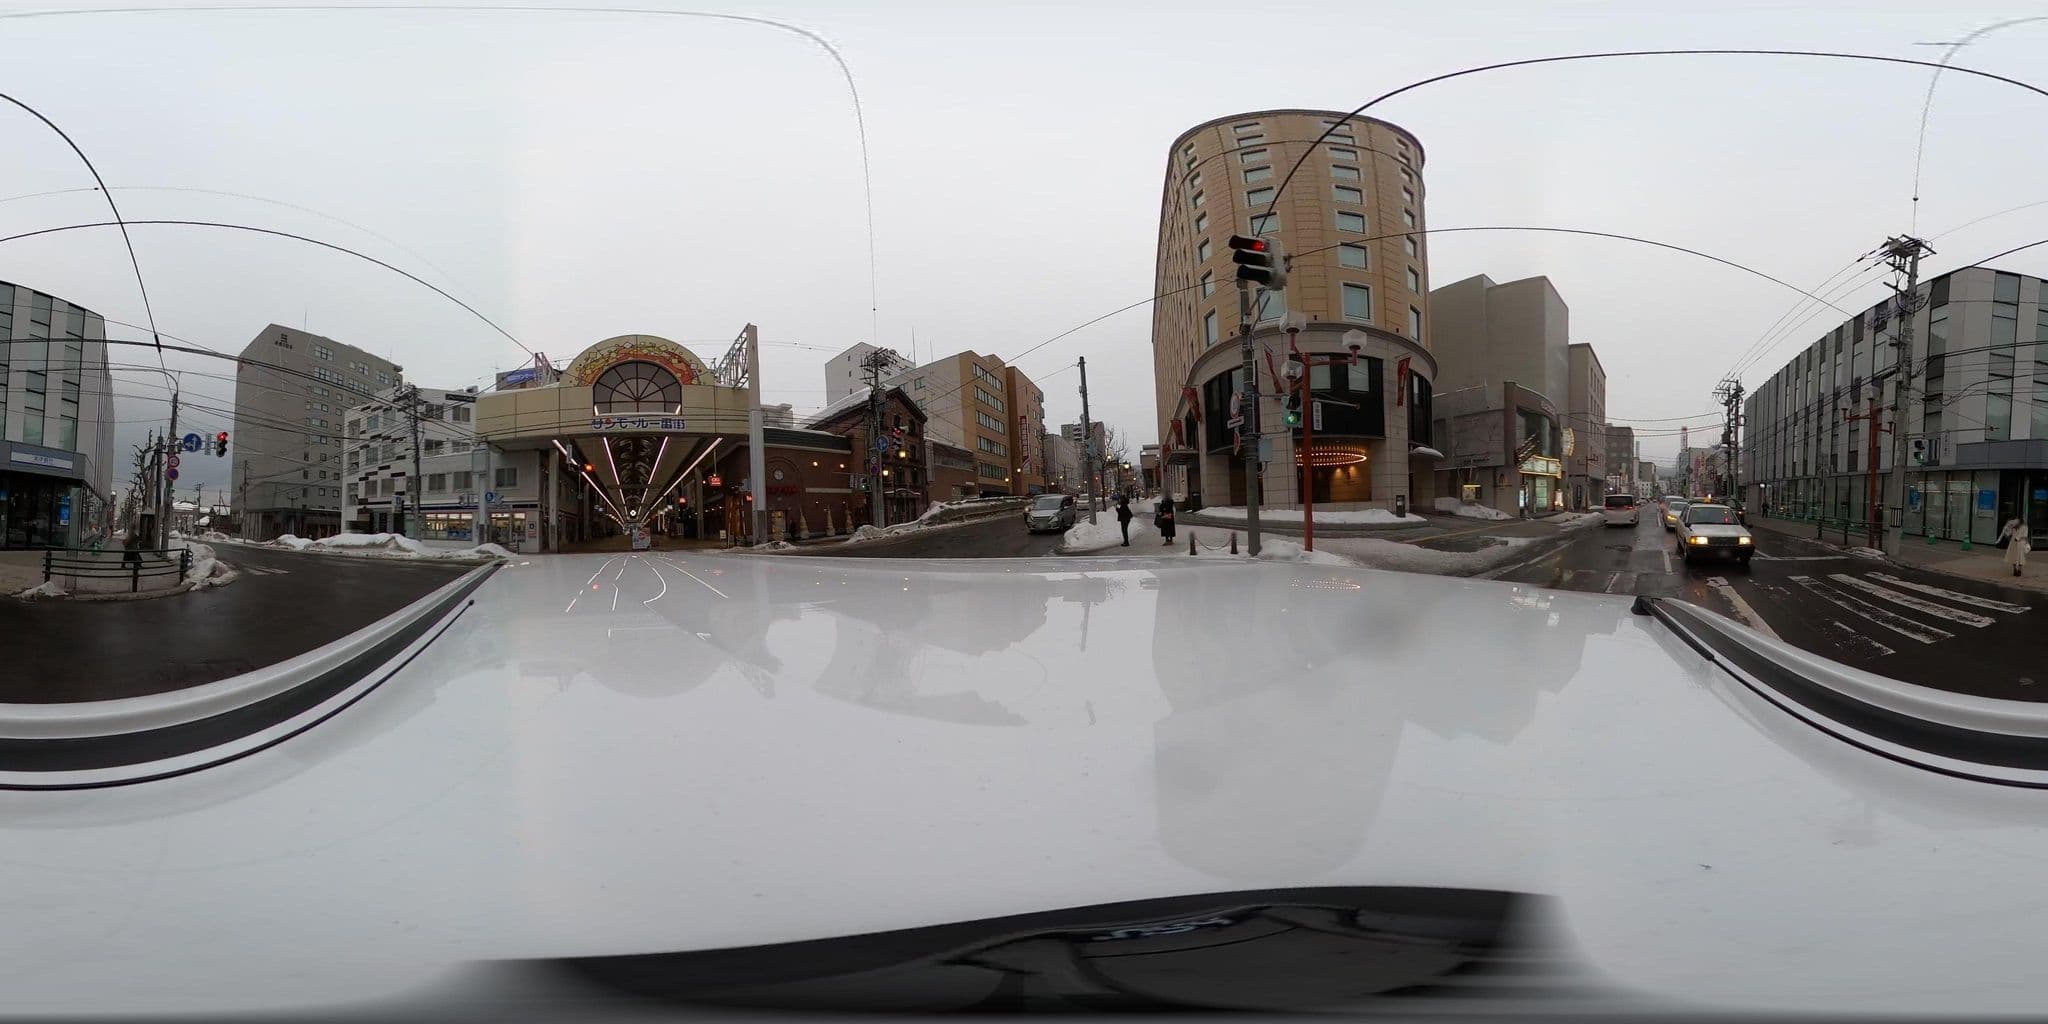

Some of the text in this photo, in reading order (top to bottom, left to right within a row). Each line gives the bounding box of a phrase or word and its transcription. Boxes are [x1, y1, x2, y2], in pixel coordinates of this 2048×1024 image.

[592, 417, 685, 430] サンモール一番街
